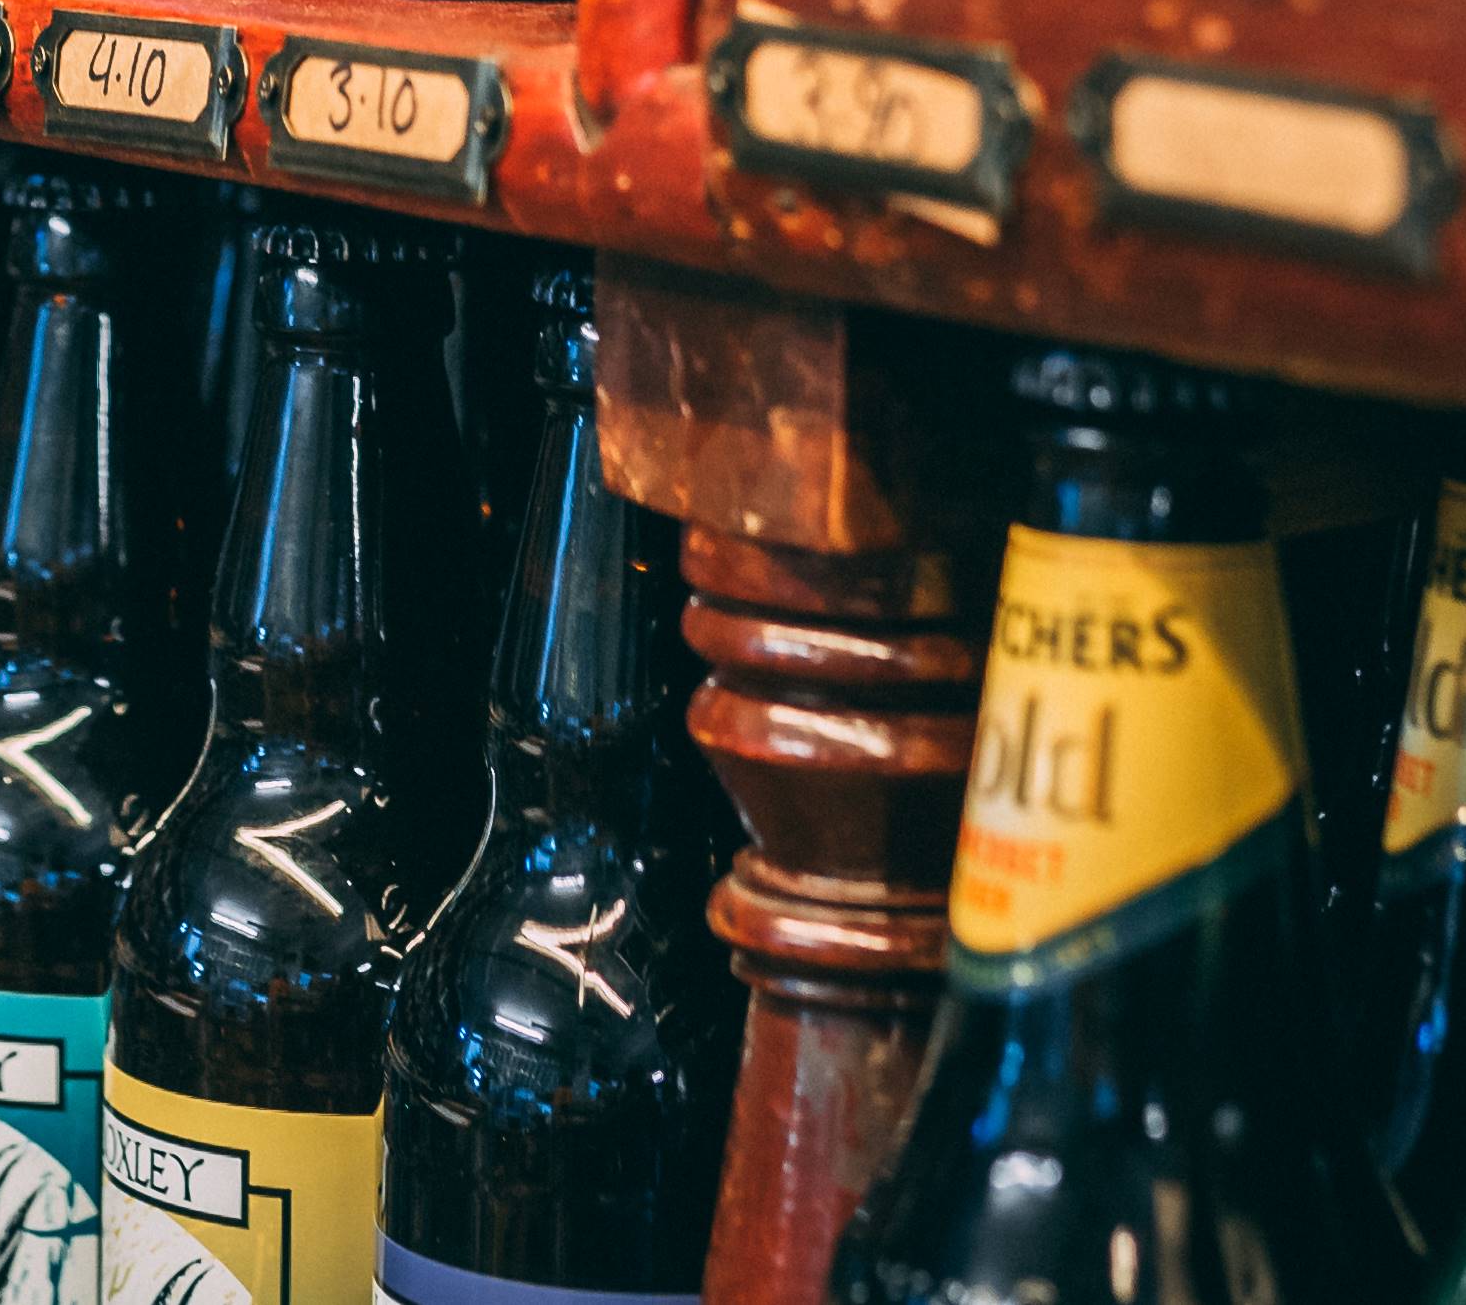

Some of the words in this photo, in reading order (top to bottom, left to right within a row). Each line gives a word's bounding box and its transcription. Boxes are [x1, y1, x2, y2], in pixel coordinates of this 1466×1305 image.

[87, 33, 167, 108] 4.10
[328, 60, 419, 136] 3.10
[999, 602, 1190, 675] CHERS
